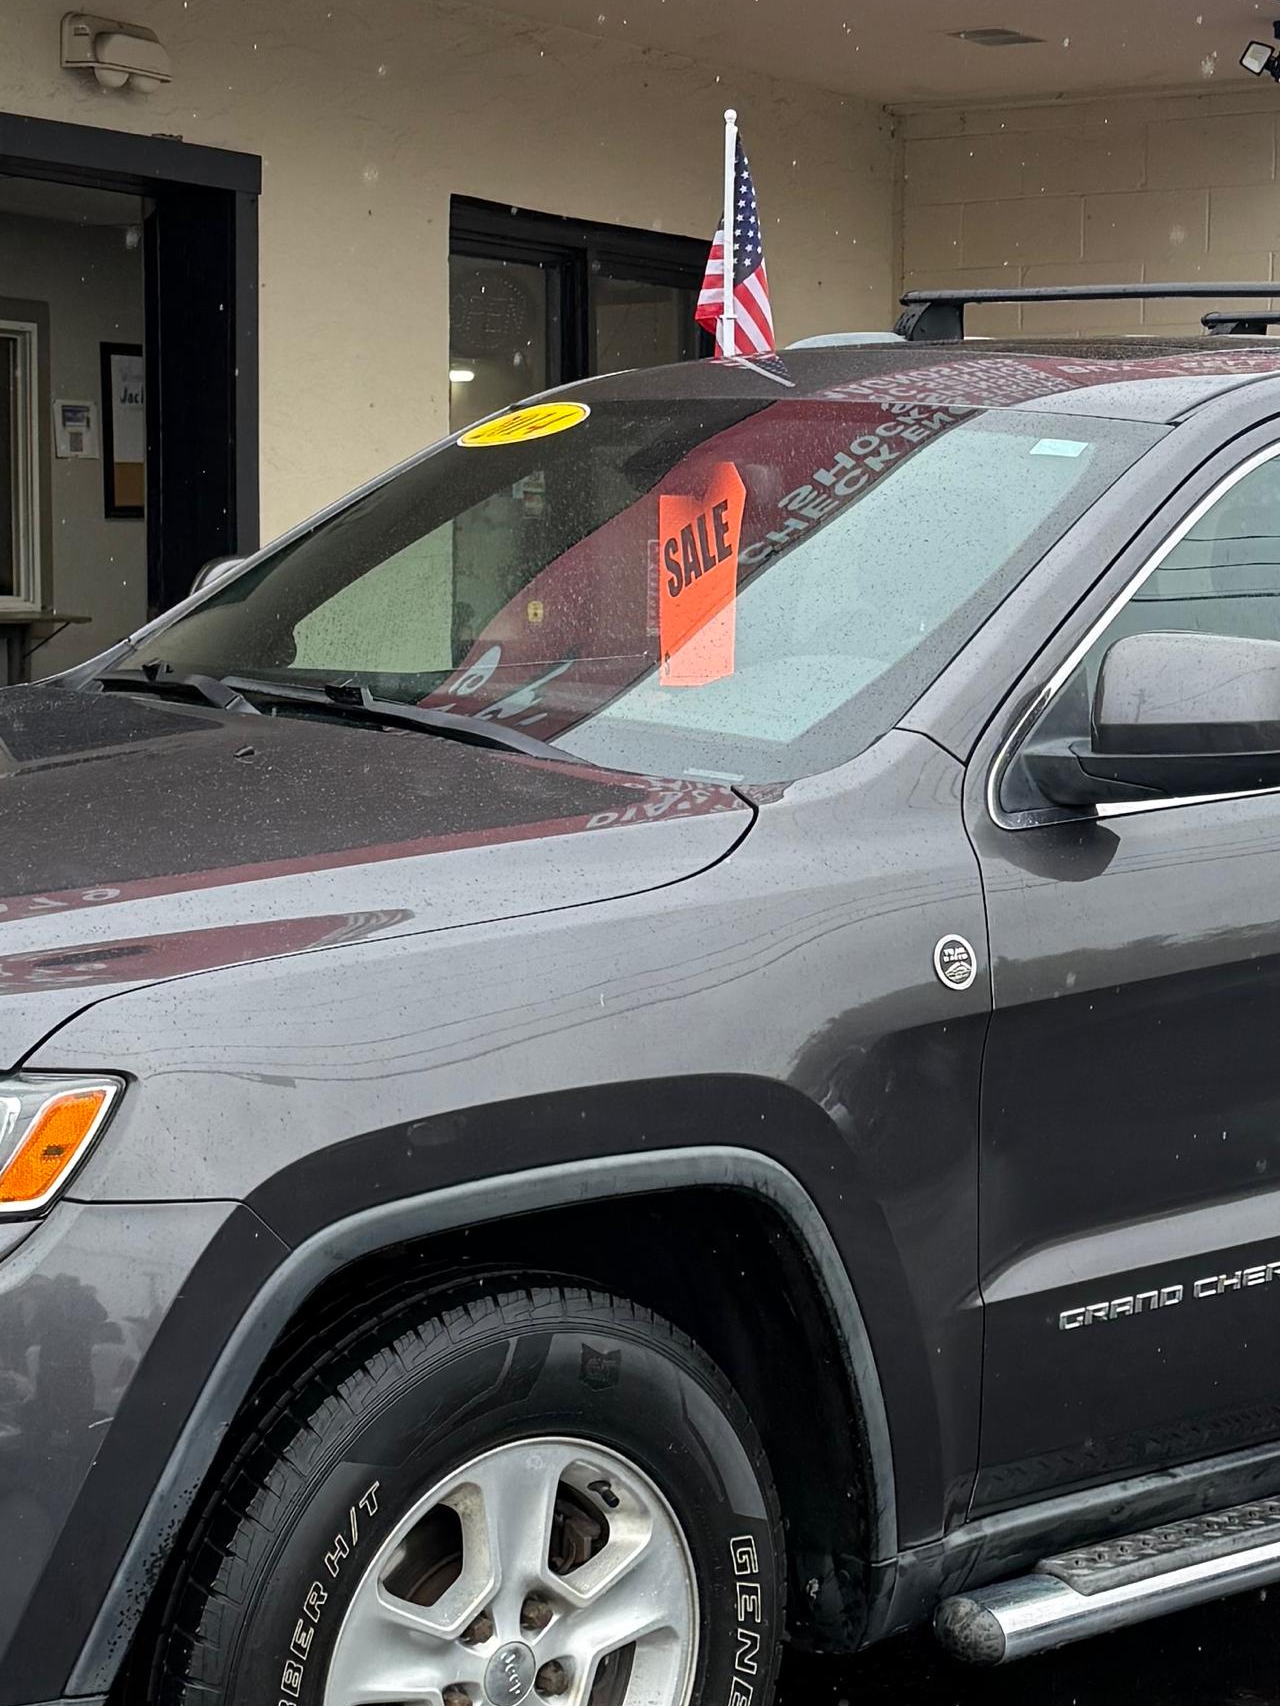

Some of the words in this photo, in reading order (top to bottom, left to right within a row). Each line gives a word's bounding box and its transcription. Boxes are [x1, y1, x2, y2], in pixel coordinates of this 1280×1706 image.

[663, 499, 733, 598] SALE
[1058, 1284, 1184, 1331] GRAND
[324, 1481, 384, 1580] H/T
